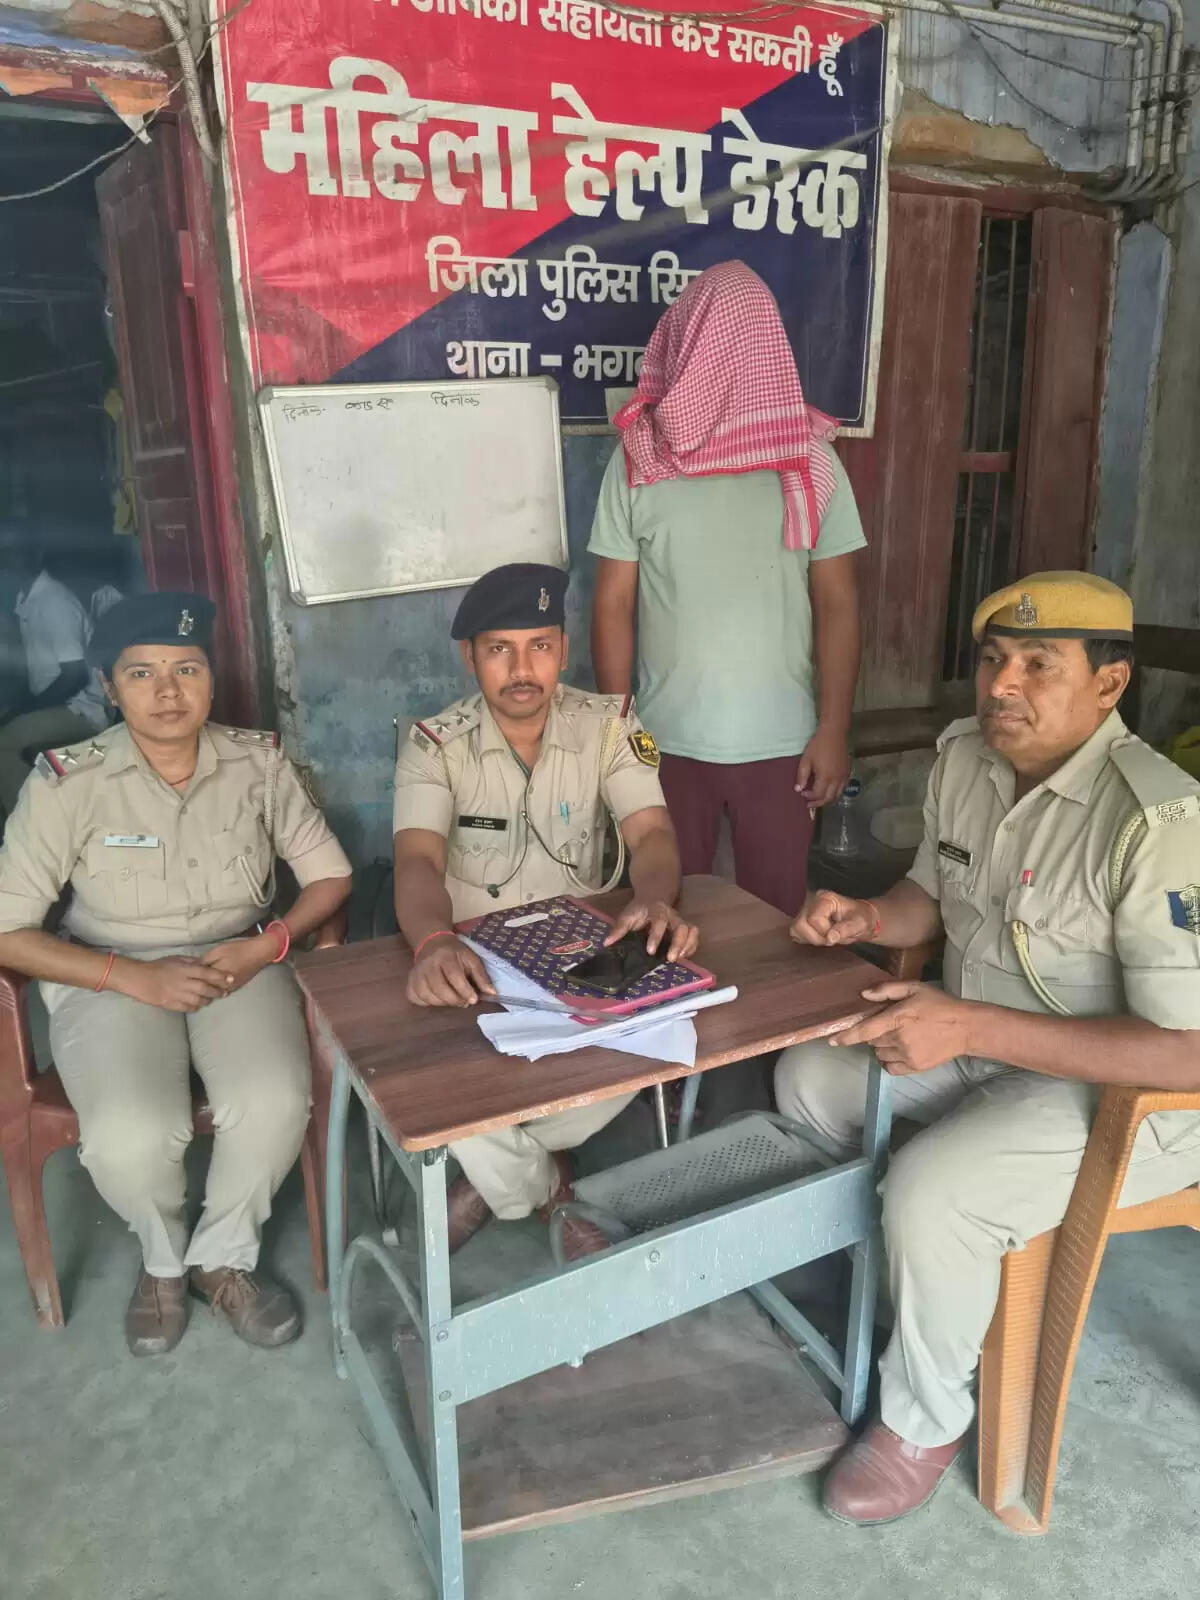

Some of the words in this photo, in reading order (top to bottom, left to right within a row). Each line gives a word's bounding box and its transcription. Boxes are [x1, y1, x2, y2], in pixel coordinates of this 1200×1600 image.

[539, 0, 664, 48] सहायता
[669, 15, 722, 58] कर
[726, 25, 813, 73] सकती
[818, 32, 844, 97] हूँ
[246, 56, 539, 211] महिला
[551, 82, 712, 225] हेल्प
[721, 107, 867, 239] डेस्क
[425, 236, 528, 298] जिला
[537, 245, 641, 321] पुलिस
[648, 250, 704, 306] सि
[446, 340, 531, 378] थाना
